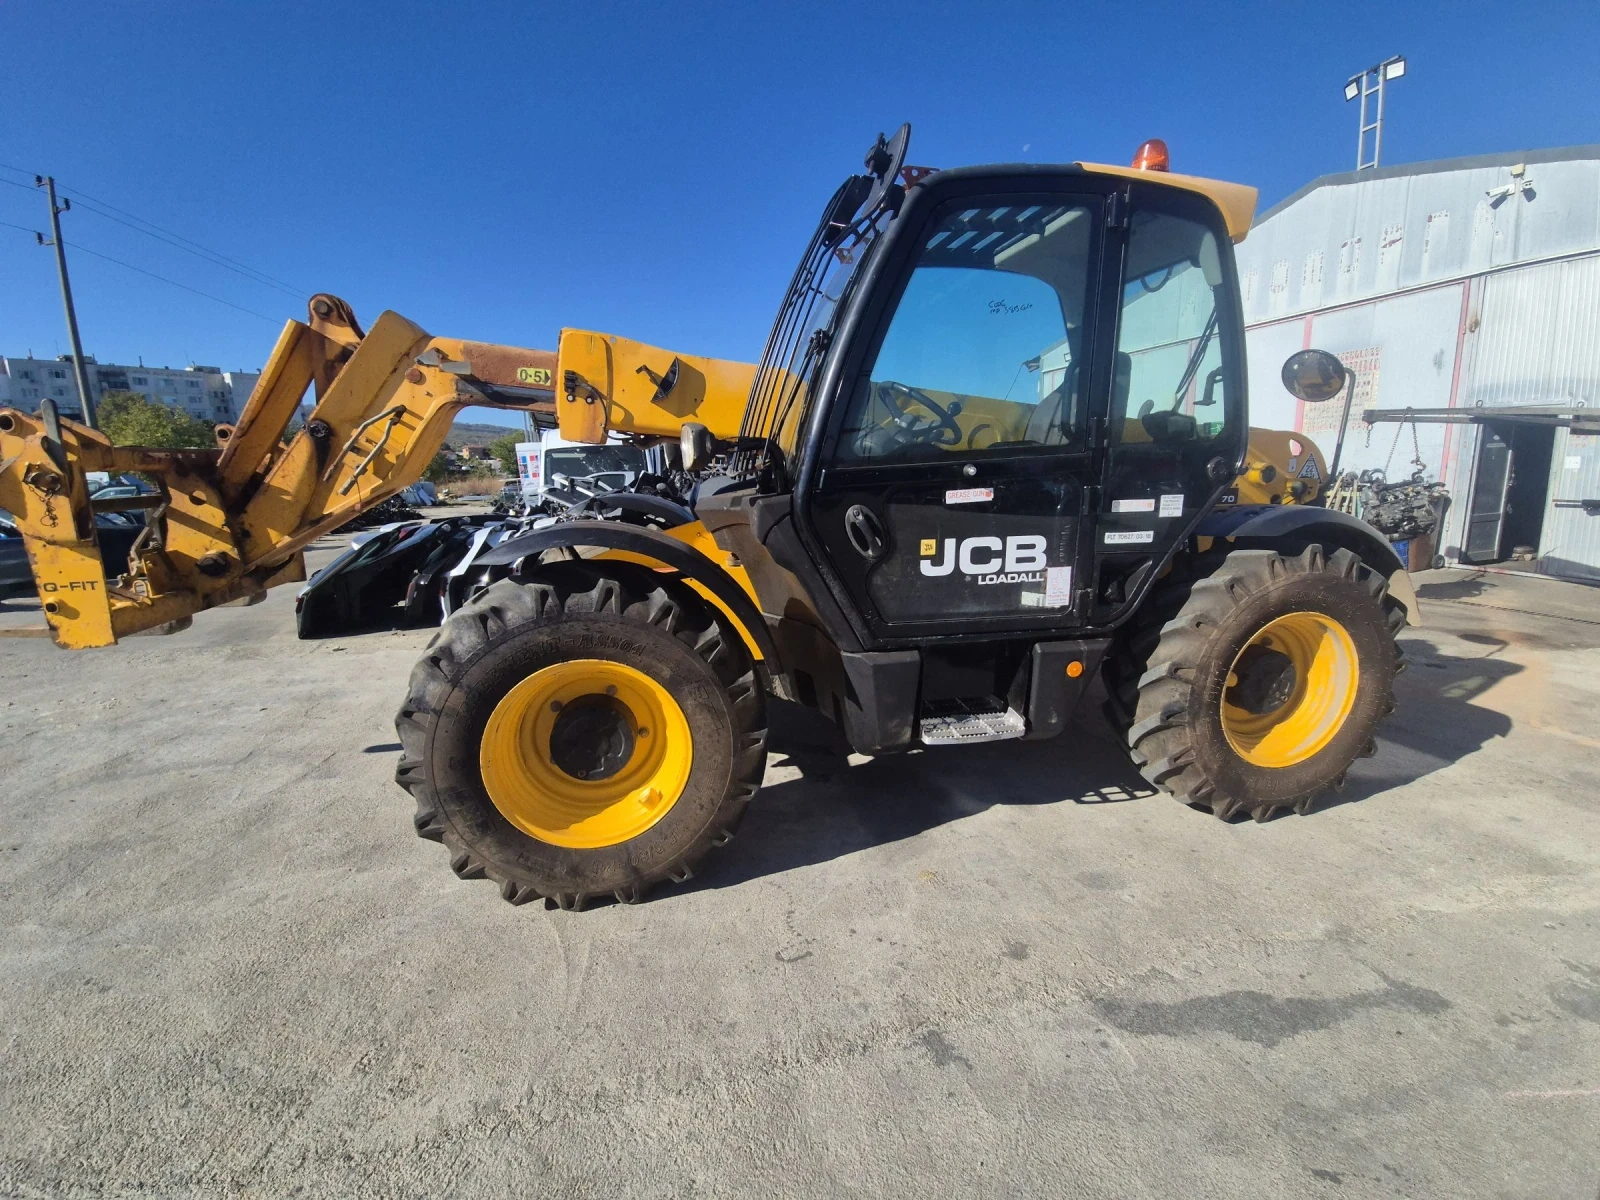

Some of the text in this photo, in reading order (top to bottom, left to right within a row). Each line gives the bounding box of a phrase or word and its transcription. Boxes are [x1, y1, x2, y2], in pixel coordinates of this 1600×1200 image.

[947, 491, 971, 499] GREASE
[919, 535, 1047, 577] JCB
[977, 573, 1044, 585] LOADALL
[43, 580, 99, 593] Q-FIT
